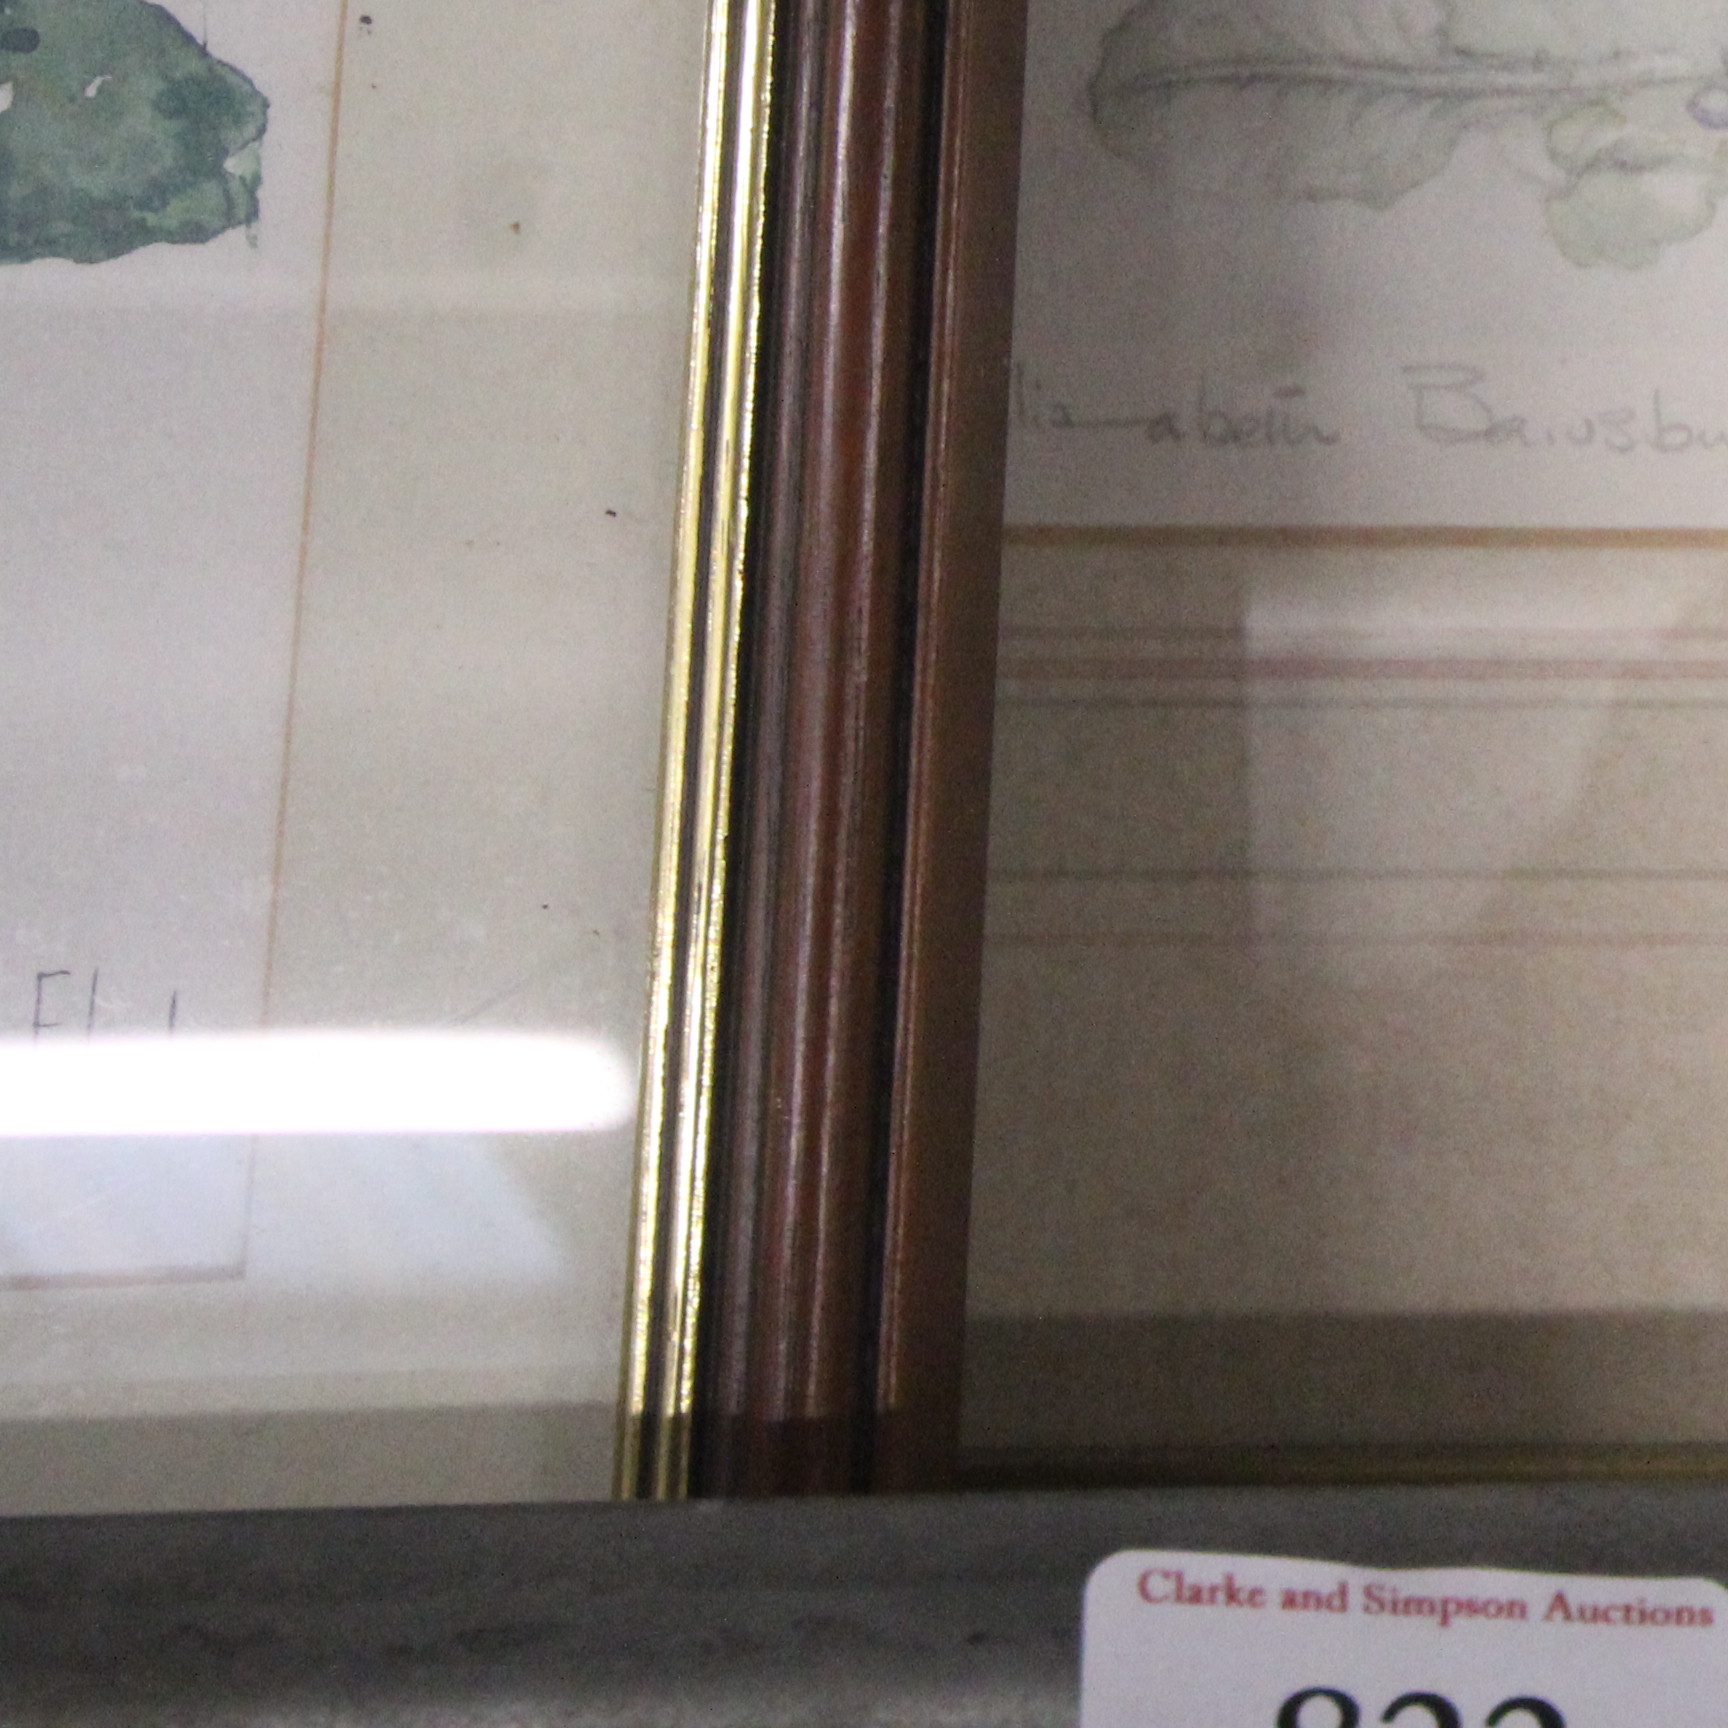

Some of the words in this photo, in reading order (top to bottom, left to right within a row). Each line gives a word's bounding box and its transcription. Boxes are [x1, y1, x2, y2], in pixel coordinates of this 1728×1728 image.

[1136, 1567, 1267, 1610] Clarke
[1279, 1579, 1350, 1614] and
[1362, 1582, 1529, 1629] Simpson
[1543, 1589, 1716, 1628] Auctions
